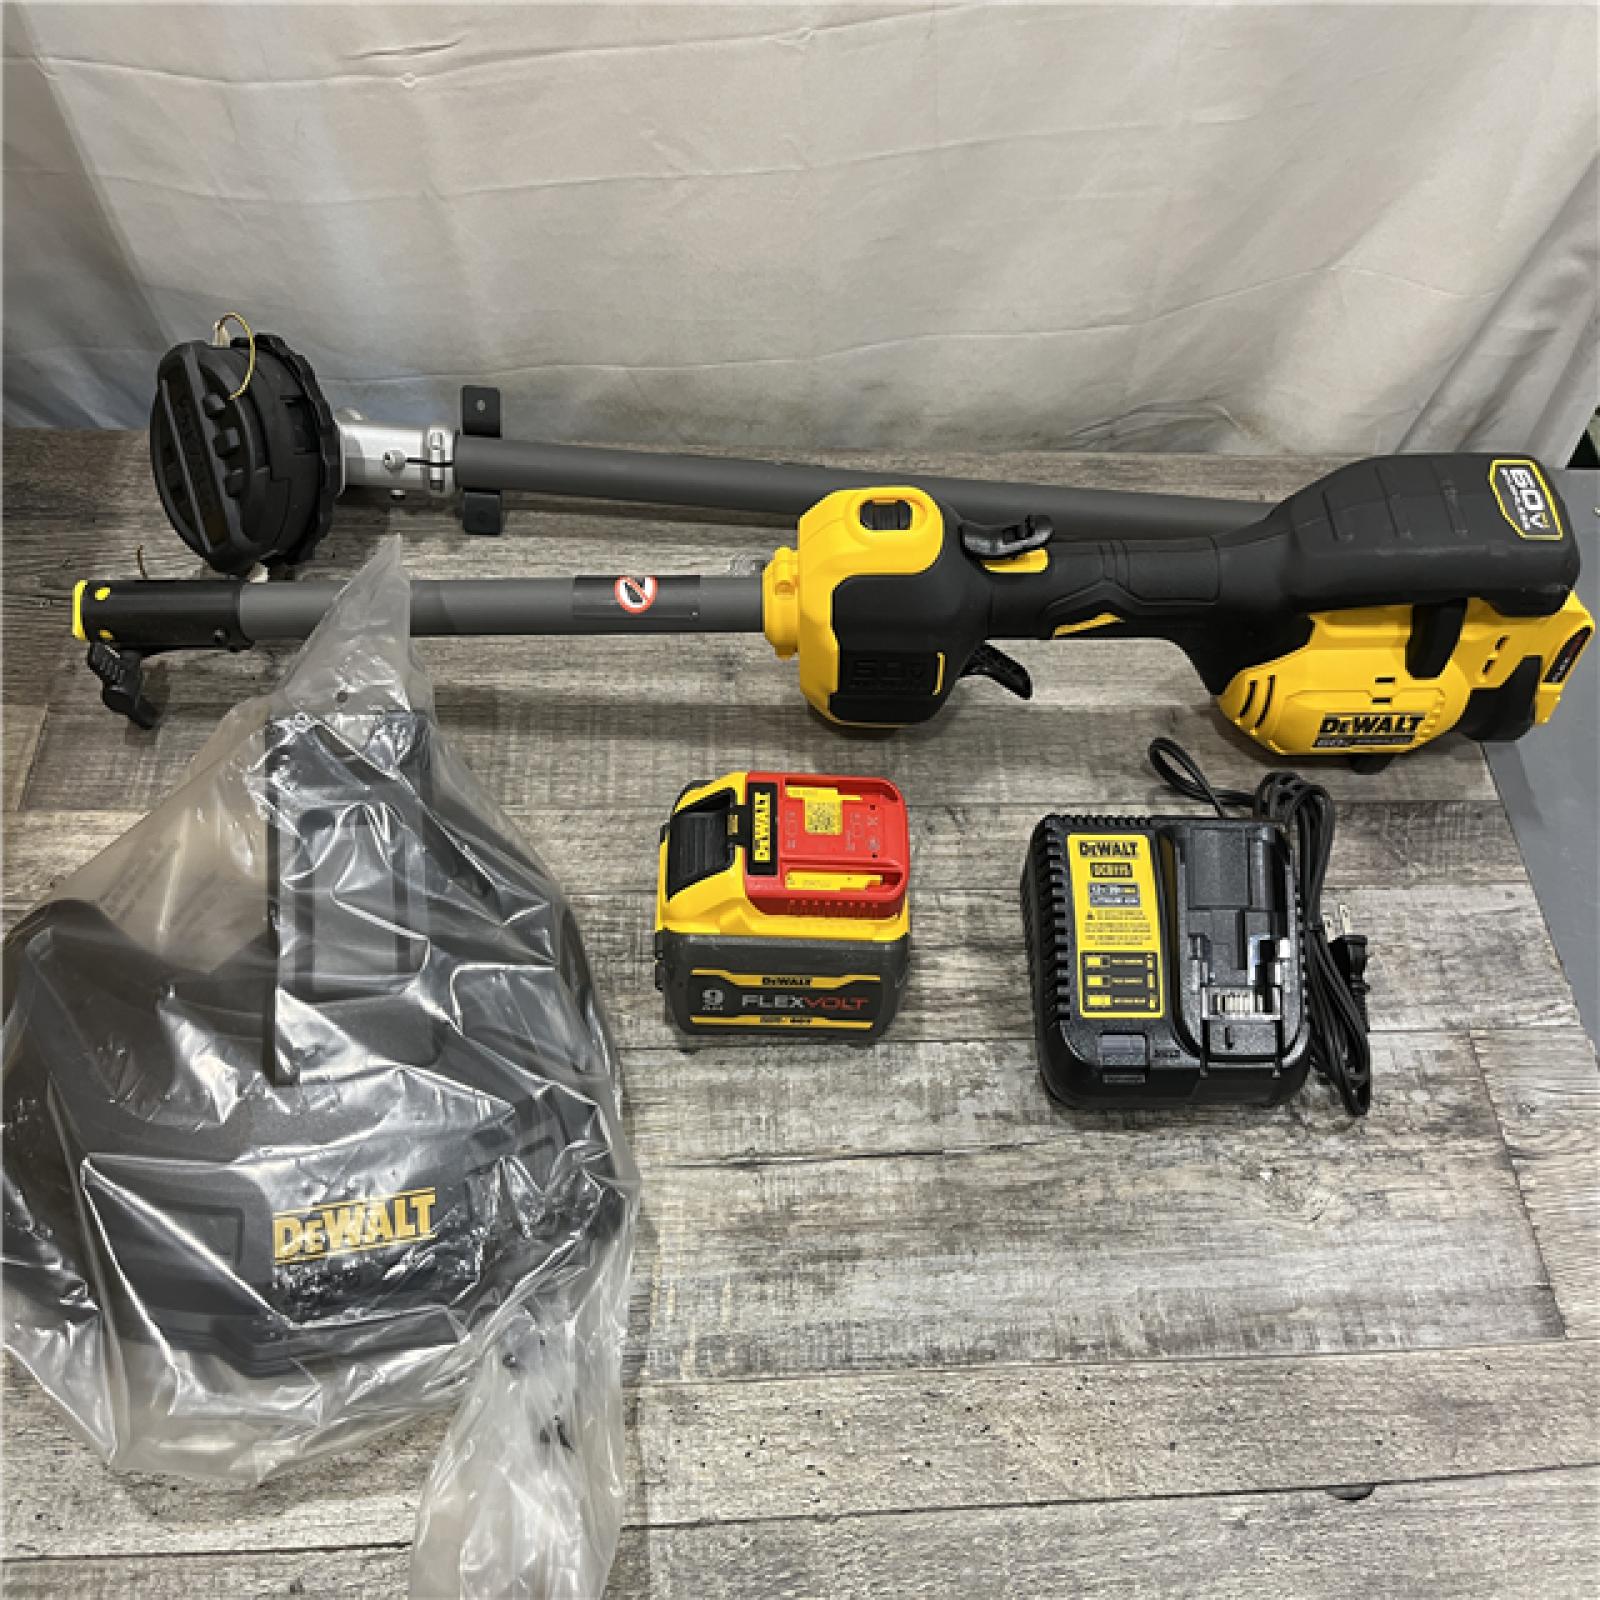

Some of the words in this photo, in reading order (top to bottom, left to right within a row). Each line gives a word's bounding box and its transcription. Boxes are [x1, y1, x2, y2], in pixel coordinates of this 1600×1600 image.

[1508, 469, 1551, 529] 60V
[1079, 841, 1139, 857] DEWALT
[702, 989, 725, 1005] 9
[741, 994, 869, 1010] FLEXVOLT
[273, 1193, 436, 1259] DEWALT
